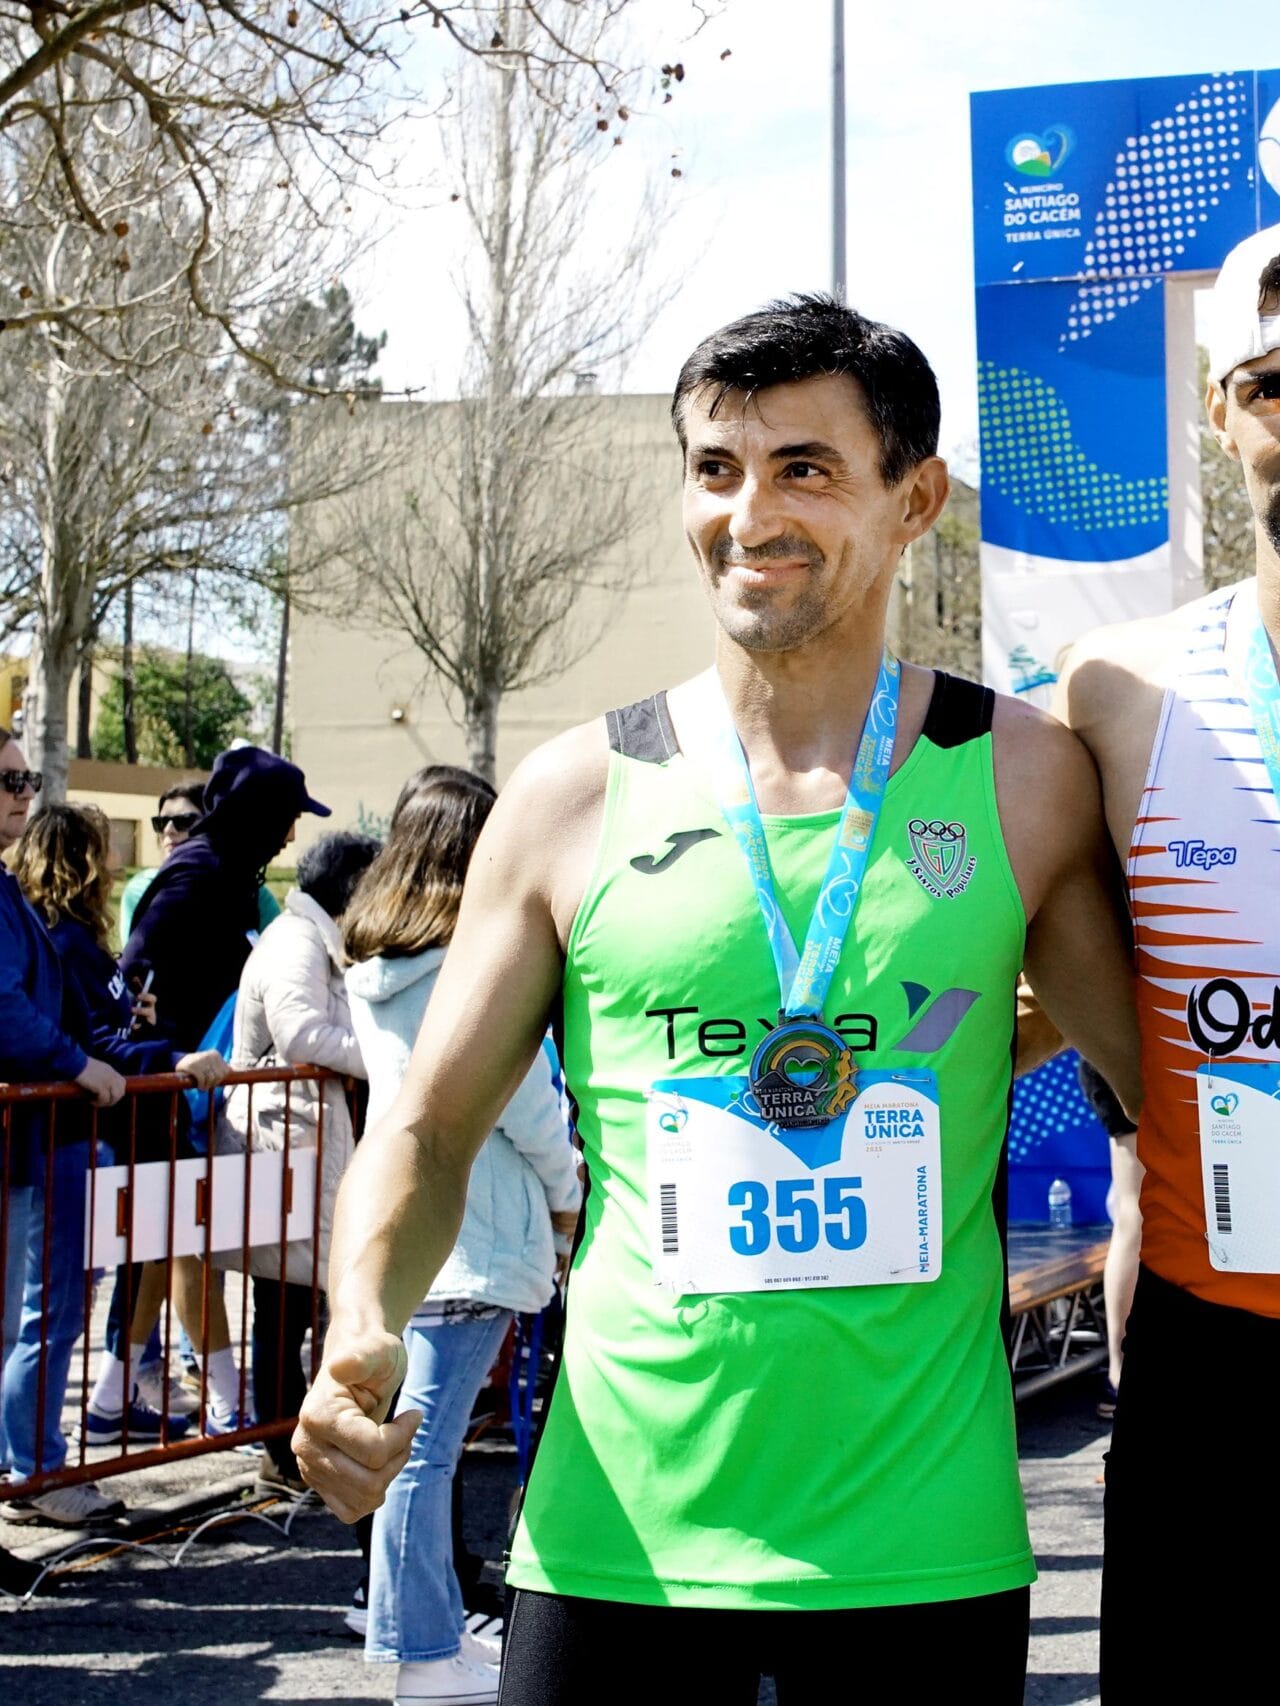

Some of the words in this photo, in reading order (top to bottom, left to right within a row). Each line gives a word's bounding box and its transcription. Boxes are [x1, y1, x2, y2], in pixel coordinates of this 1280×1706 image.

[1004, 193, 1079, 211] SANTIAGO
[1003, 212, 1027, 226] DO
[1029, 207, 1081, 224] CACÉM
[1005, 231, 1042, 243] TERRA
[881, 736, 895, 766] MEIA
[1168, 839, 1237, 871] Tepa
[825, 936, 842, 974] MEIA
[761, 1091, 814, 1105] TERRA
[761, 1104, 817, 1119] ÚNICA
[864, 1109, 924, 1124] TERRA
[864, 1123, 925, 1139] ÚNICA
[728, 1176, 867, 1256] 355
[917, 1165, 930, 1273] MEIA-MARATONA
